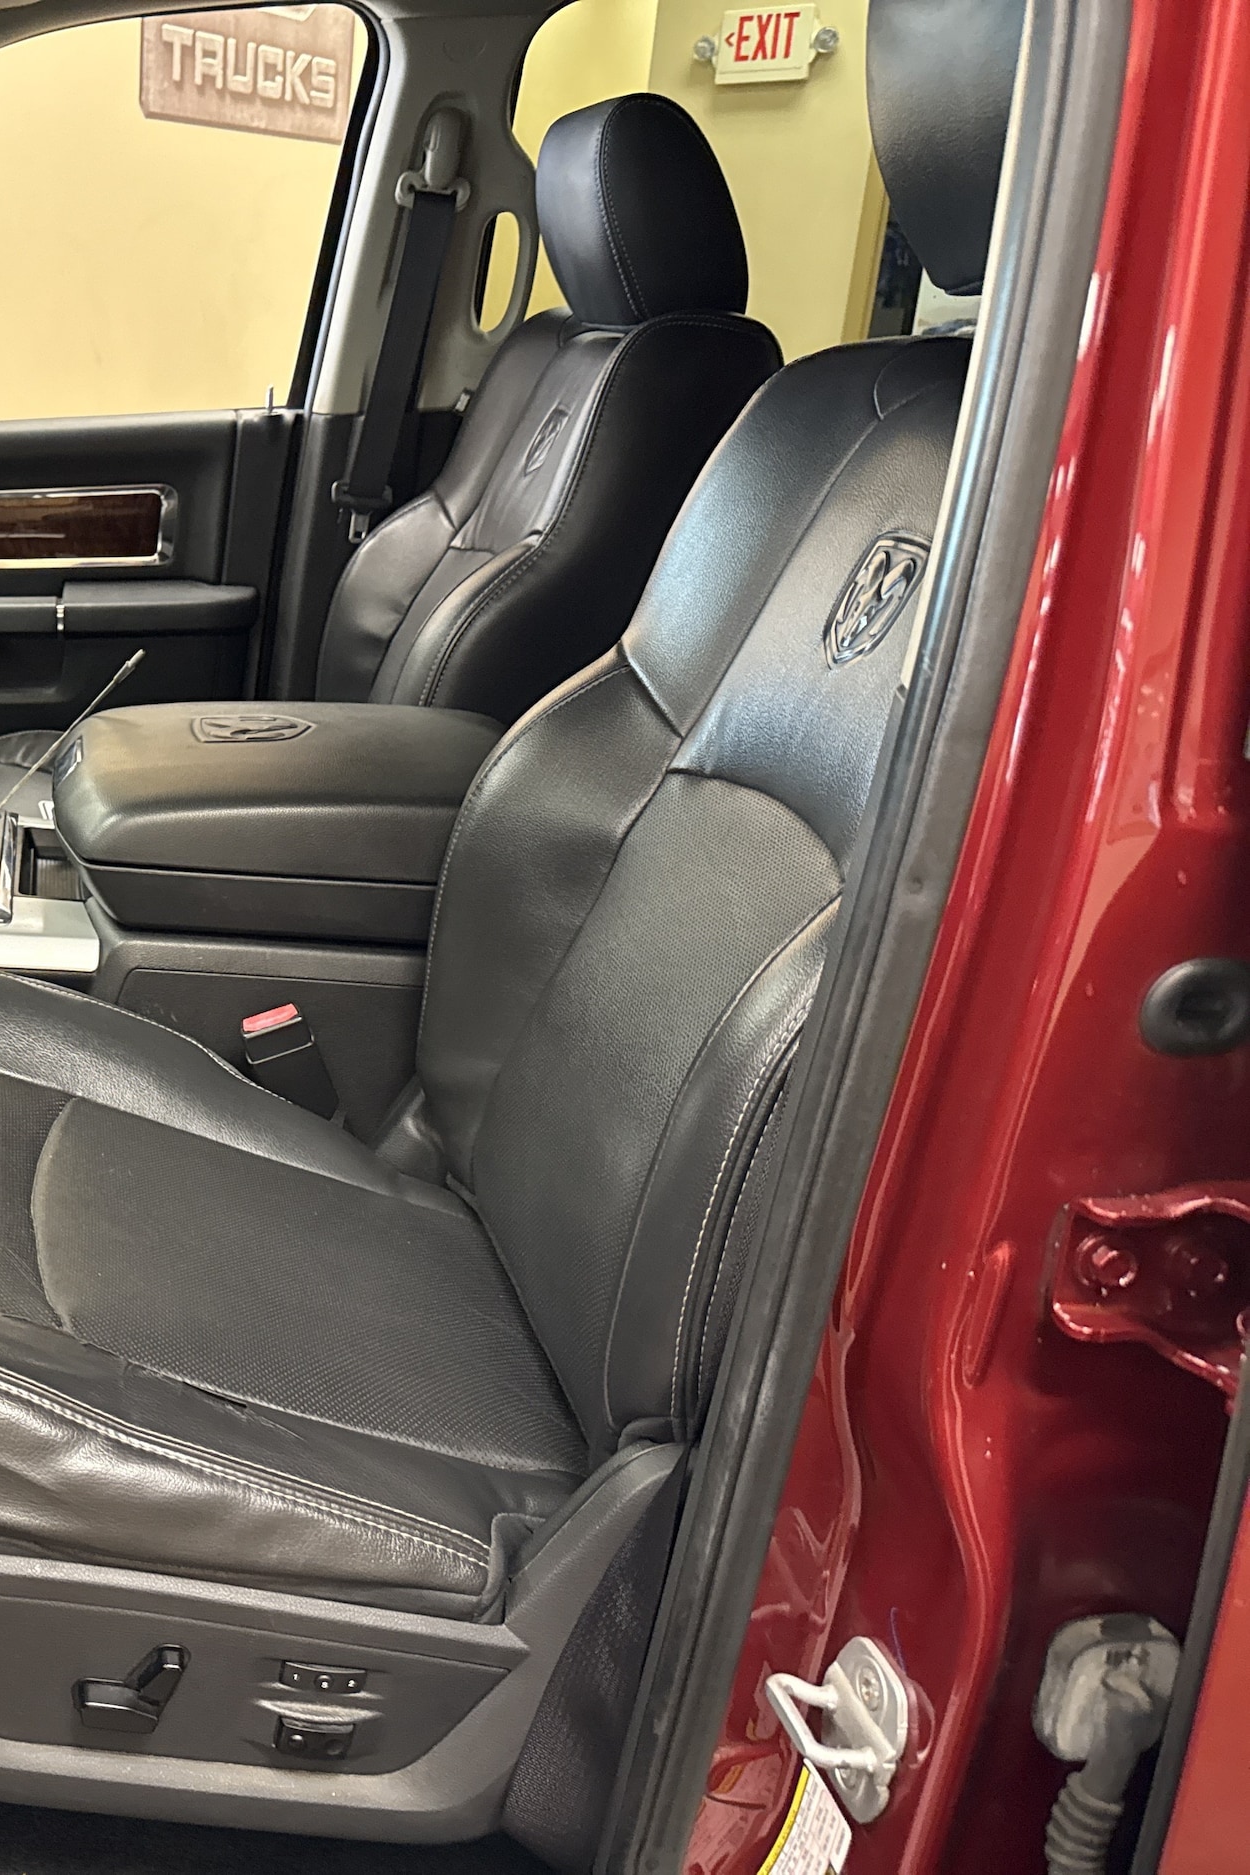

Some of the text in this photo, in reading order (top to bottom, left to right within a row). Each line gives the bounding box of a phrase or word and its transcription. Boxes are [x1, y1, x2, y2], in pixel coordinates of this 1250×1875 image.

[734, 11, 801, 62] EXIT
[161, 23, 336, 108] TRUCKS
[347, 1679, 355, 1687] 2
